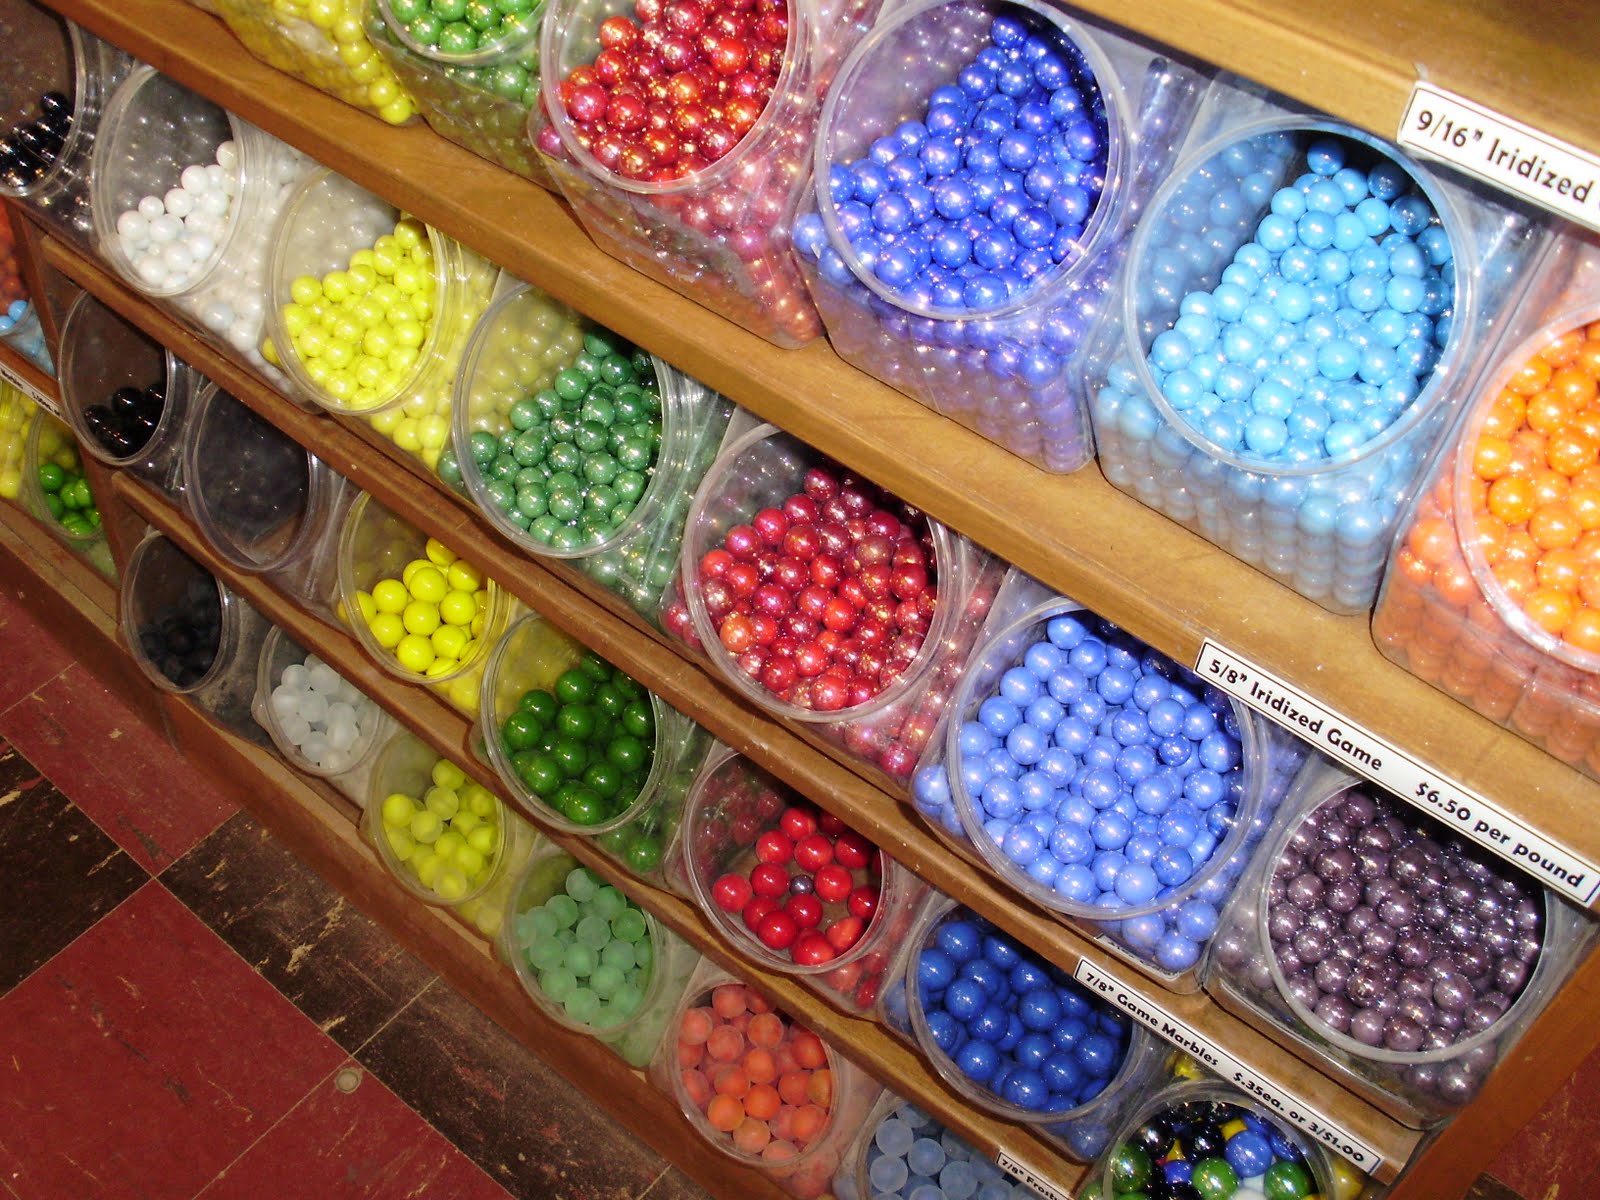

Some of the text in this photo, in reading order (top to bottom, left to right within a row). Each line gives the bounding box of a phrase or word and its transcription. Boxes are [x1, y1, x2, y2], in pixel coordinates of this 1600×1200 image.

[1417, 110, 1594, 203] 9/16" Iridized
[1209, 659, 1585, 888] 5/8" Iridized Game $6.50 per pound
[1117, 993, 1158, 1026] Game
[1162, 1022, 1219, 1066] Marbles
[1232, 1071, 1285, 1111] $.35ea.
[1289, 1110, 1307, 1126] or
[1308, 1123, 1365, 1164] 3/$1.00
